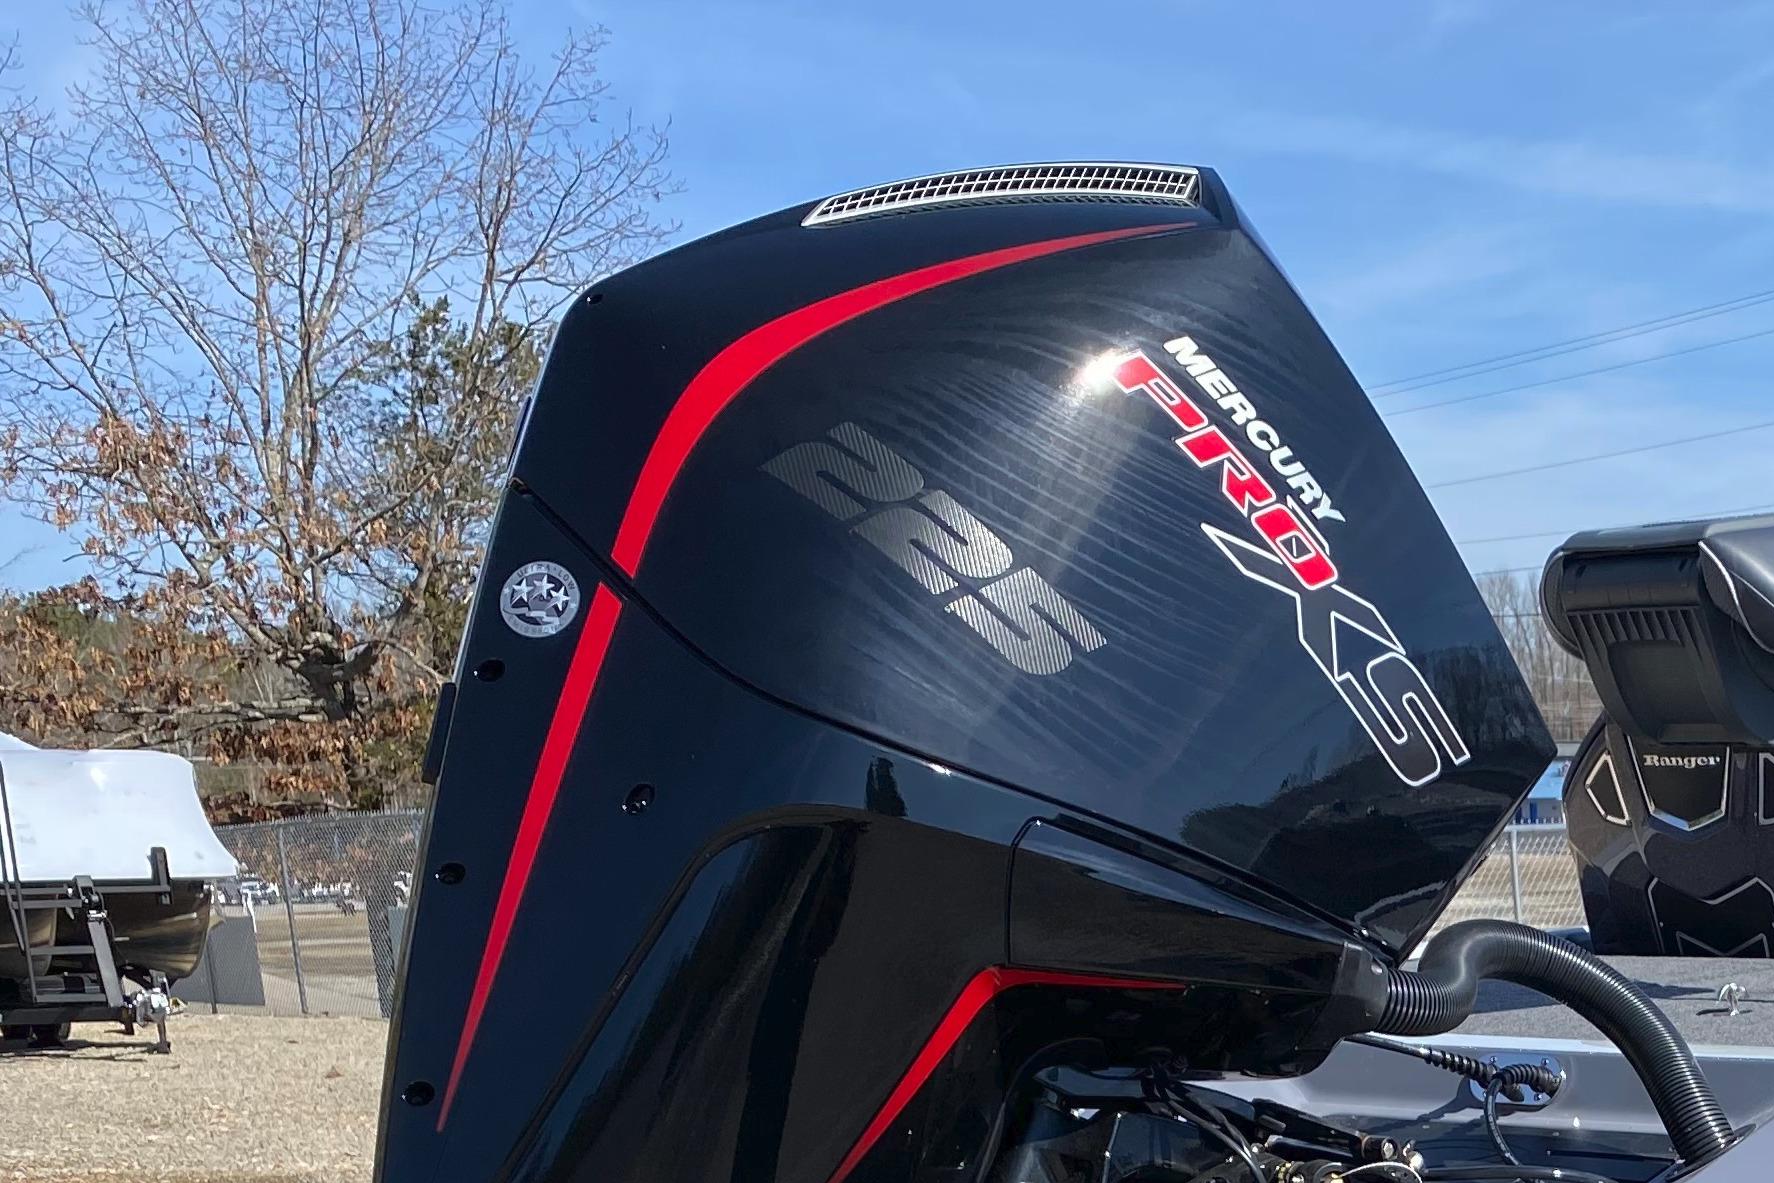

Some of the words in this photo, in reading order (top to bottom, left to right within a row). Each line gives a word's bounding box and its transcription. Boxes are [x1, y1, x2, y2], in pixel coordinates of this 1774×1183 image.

[1112, 350, 1339, 591] PRO
[1162, 335, 1346, 523] MERCURY
[758, 421, 1108, 675] 225
[1642, 754, 1721, 769] Ranger
